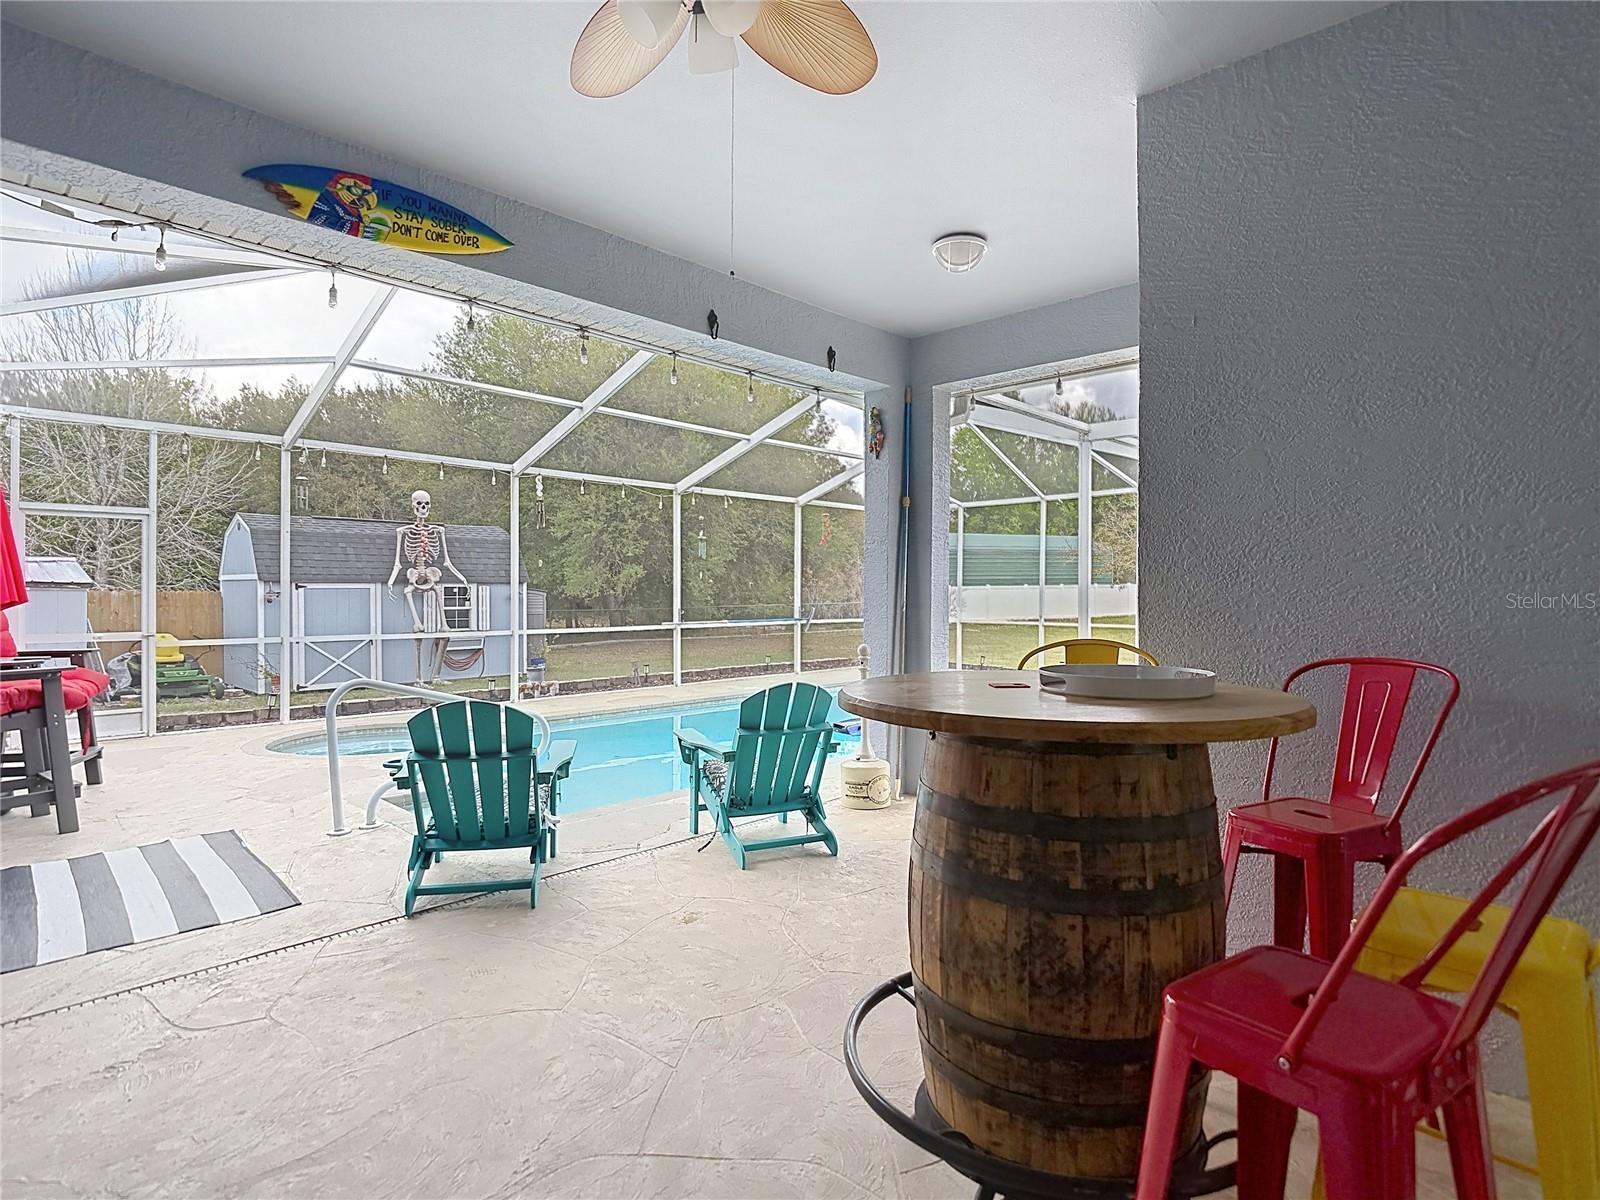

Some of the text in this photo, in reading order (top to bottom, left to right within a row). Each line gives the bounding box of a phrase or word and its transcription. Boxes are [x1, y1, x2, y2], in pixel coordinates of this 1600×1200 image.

[381, 188, 467, 222] IF YOU WANNA
[392, 221, 480, 249] DON'T COME OVER
[393, 207, 467, 235] STAY SOBER
